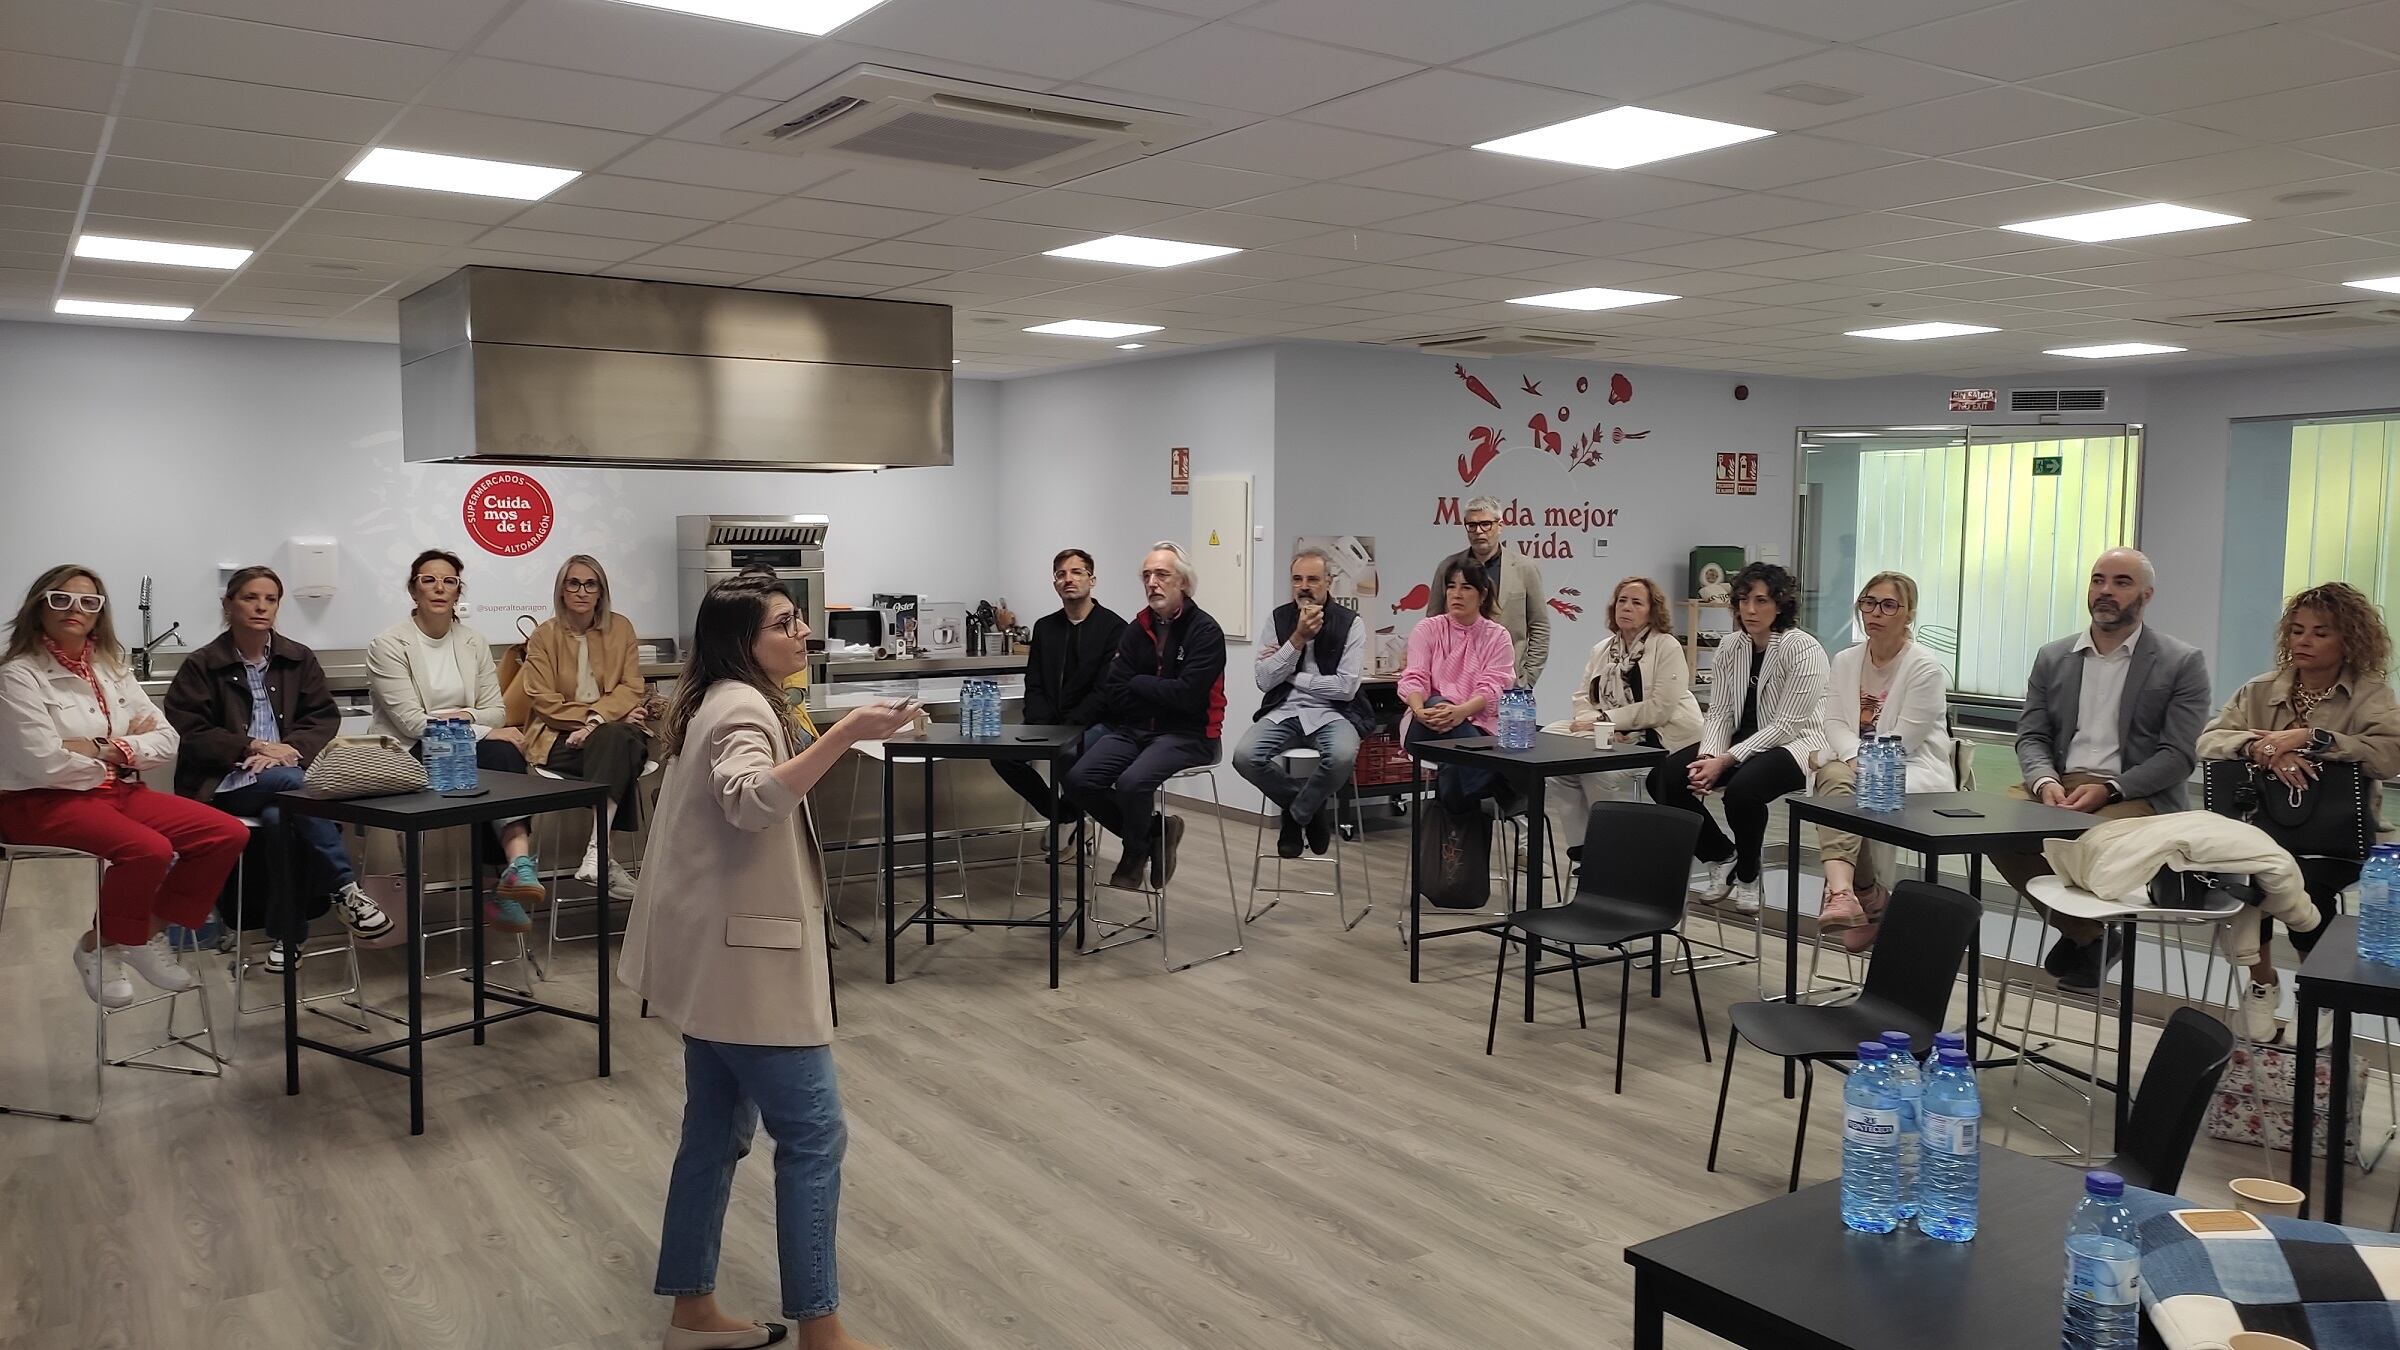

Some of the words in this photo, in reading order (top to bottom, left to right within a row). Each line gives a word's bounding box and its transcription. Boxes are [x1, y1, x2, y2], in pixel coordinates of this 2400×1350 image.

[1958, 402, 1970, 410] NO
[1973, 402, 1988, 410] EXIT
[467, 475, 525, 523] SUPERMERCADOS
[483, 495, 531, 509] Cuida
[484, 510, 518, 520] mos
[1433, 497, 1535, 527] Mda
[1544, 501, 1619, 533] mejor
[496, 520, 516, 533] de
[520, 520, 532, 533] ti
[504, 515, 550, 553] ALTOARAGÓN
[1517, 532, 1573, 559] vida
[892, 602, 915, 614] Oster
